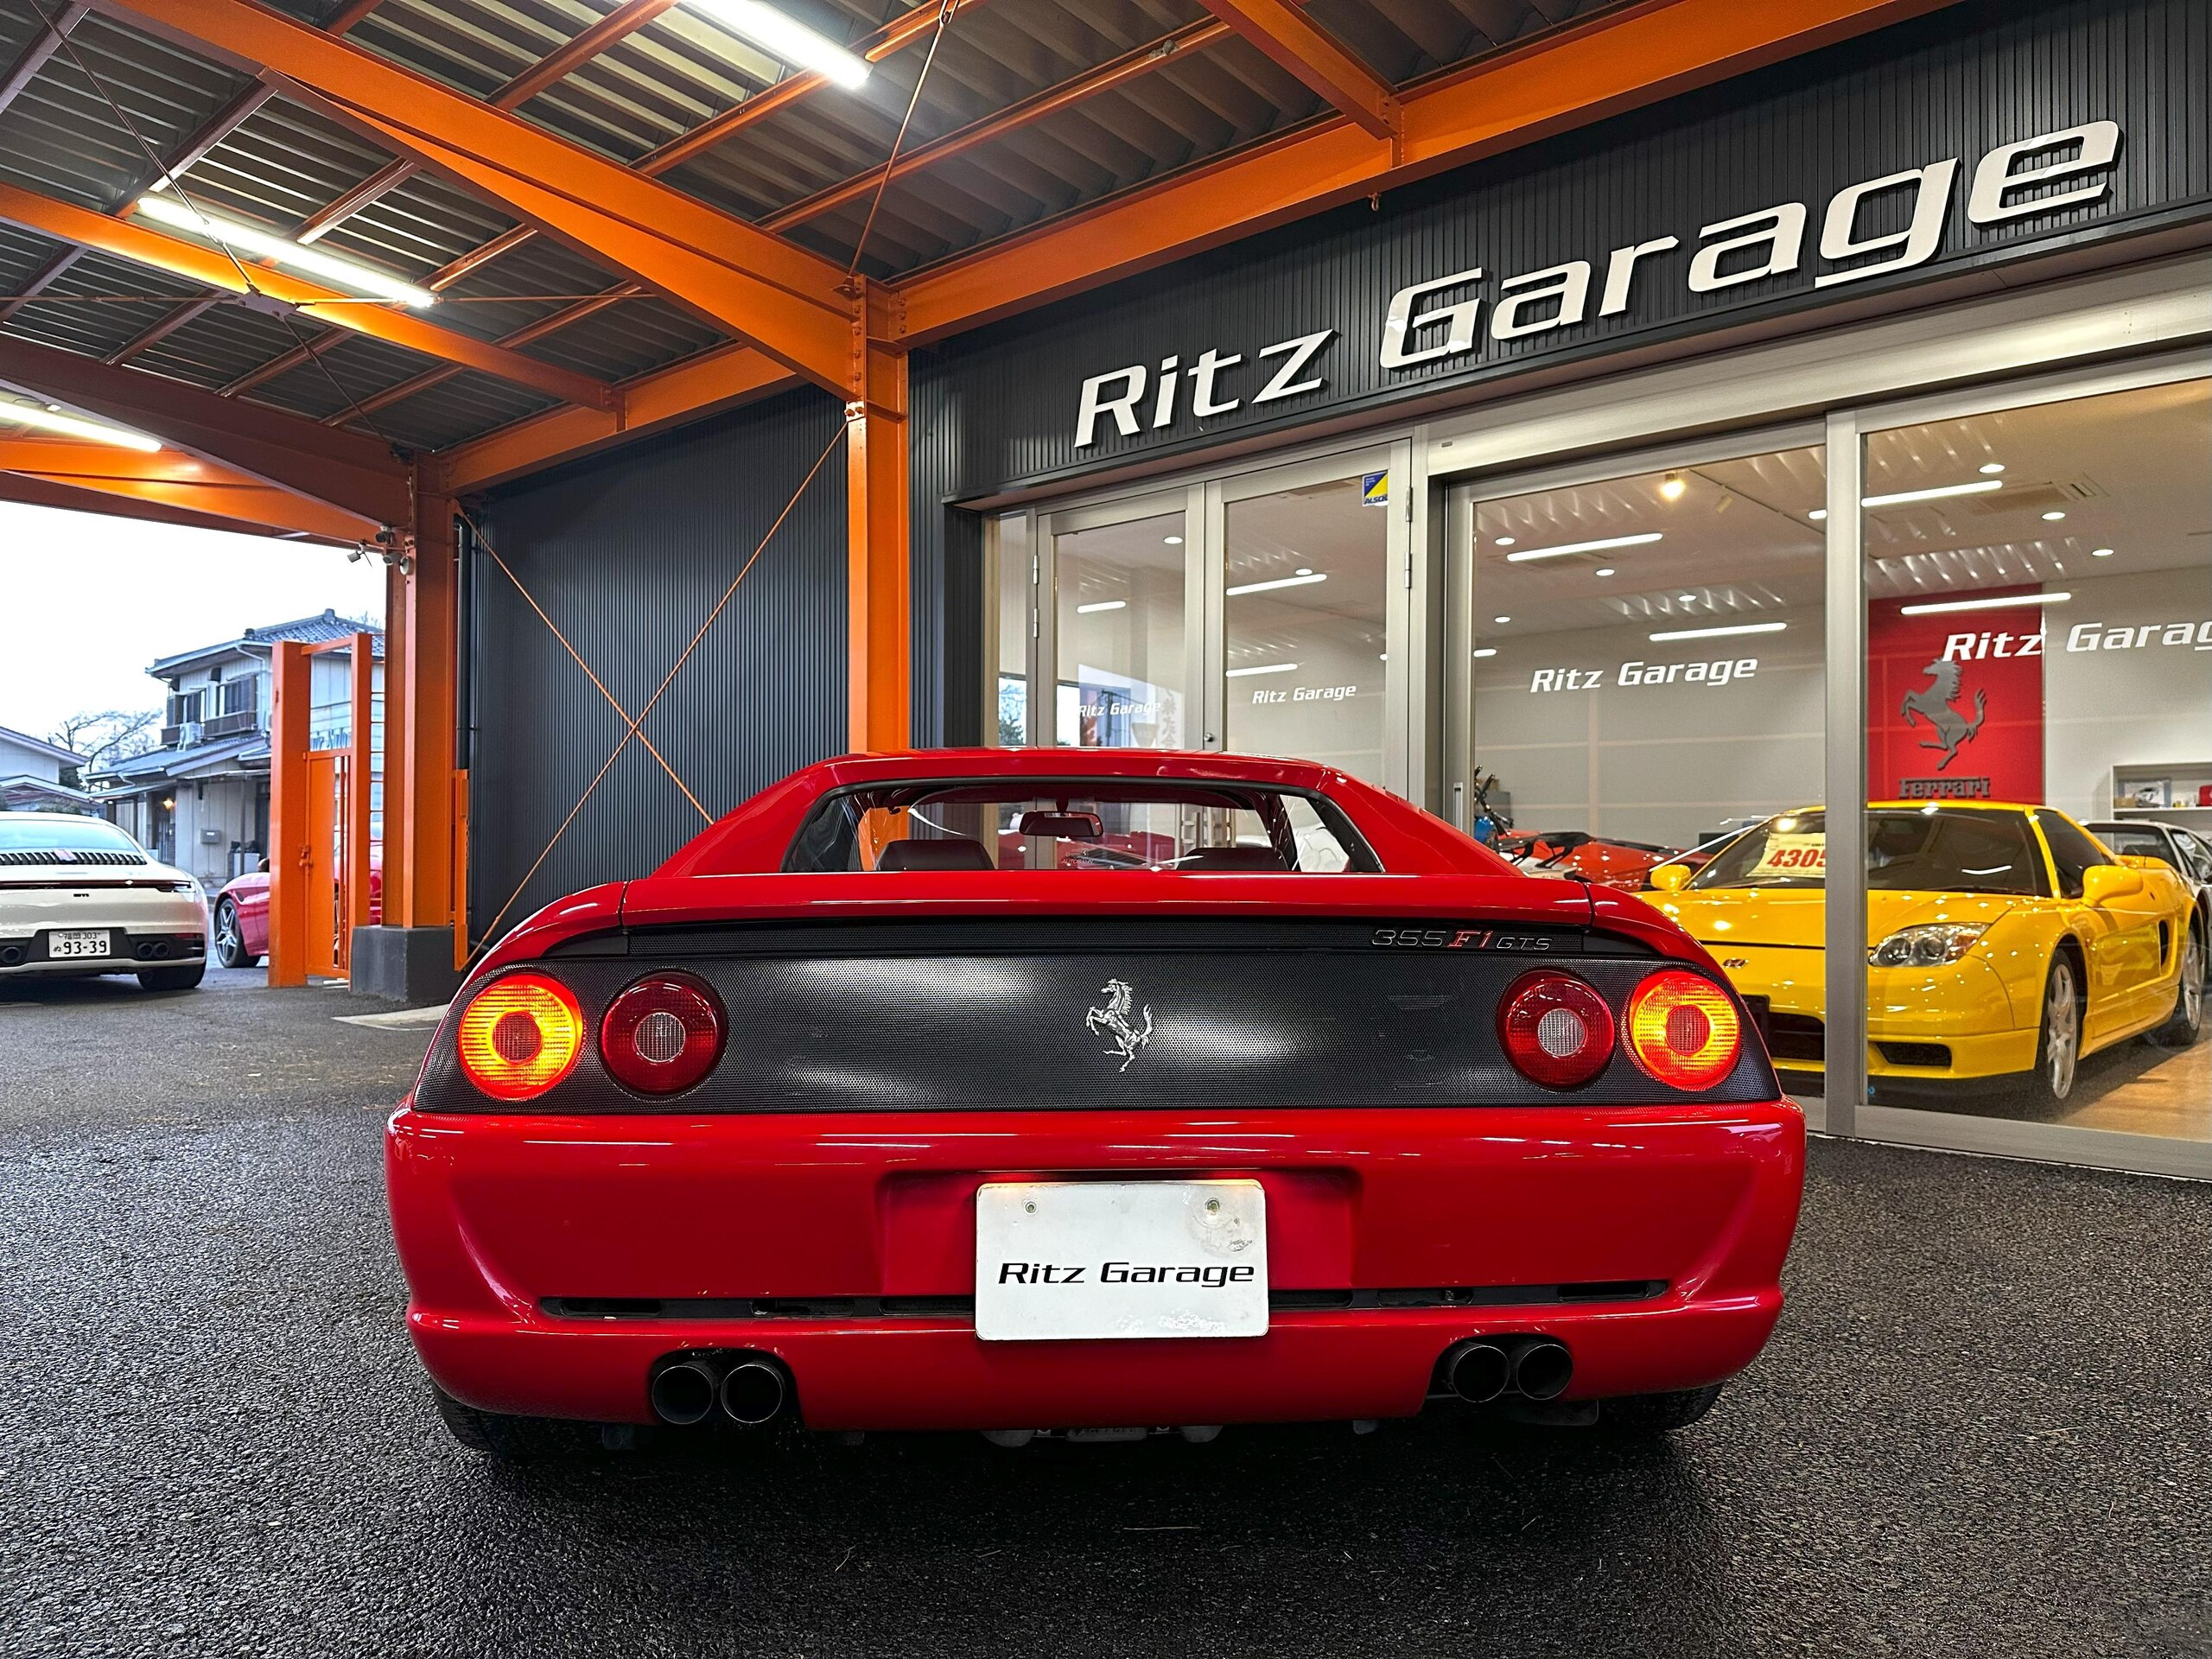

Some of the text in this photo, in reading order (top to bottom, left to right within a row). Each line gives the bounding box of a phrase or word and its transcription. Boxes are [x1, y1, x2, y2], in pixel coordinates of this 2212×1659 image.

[1074, 121, 2120, 448] Ritz Garage
[1942, 632, 2043, 662] Ritz
[1530, 658, 1758, 692] Ritz Garage
[1252, 685, 1356, 703] Ritz Garage
[1078, 702, 1160, 716] Ritz Garage
[1898, 777, 1990, 798] Ferrari
[63, 940, 107, 955] 93-39
[1372, 929, 1553, 950] 355 F1 GTS
[998, 1262, 1255, 1287] Ritz Garage
